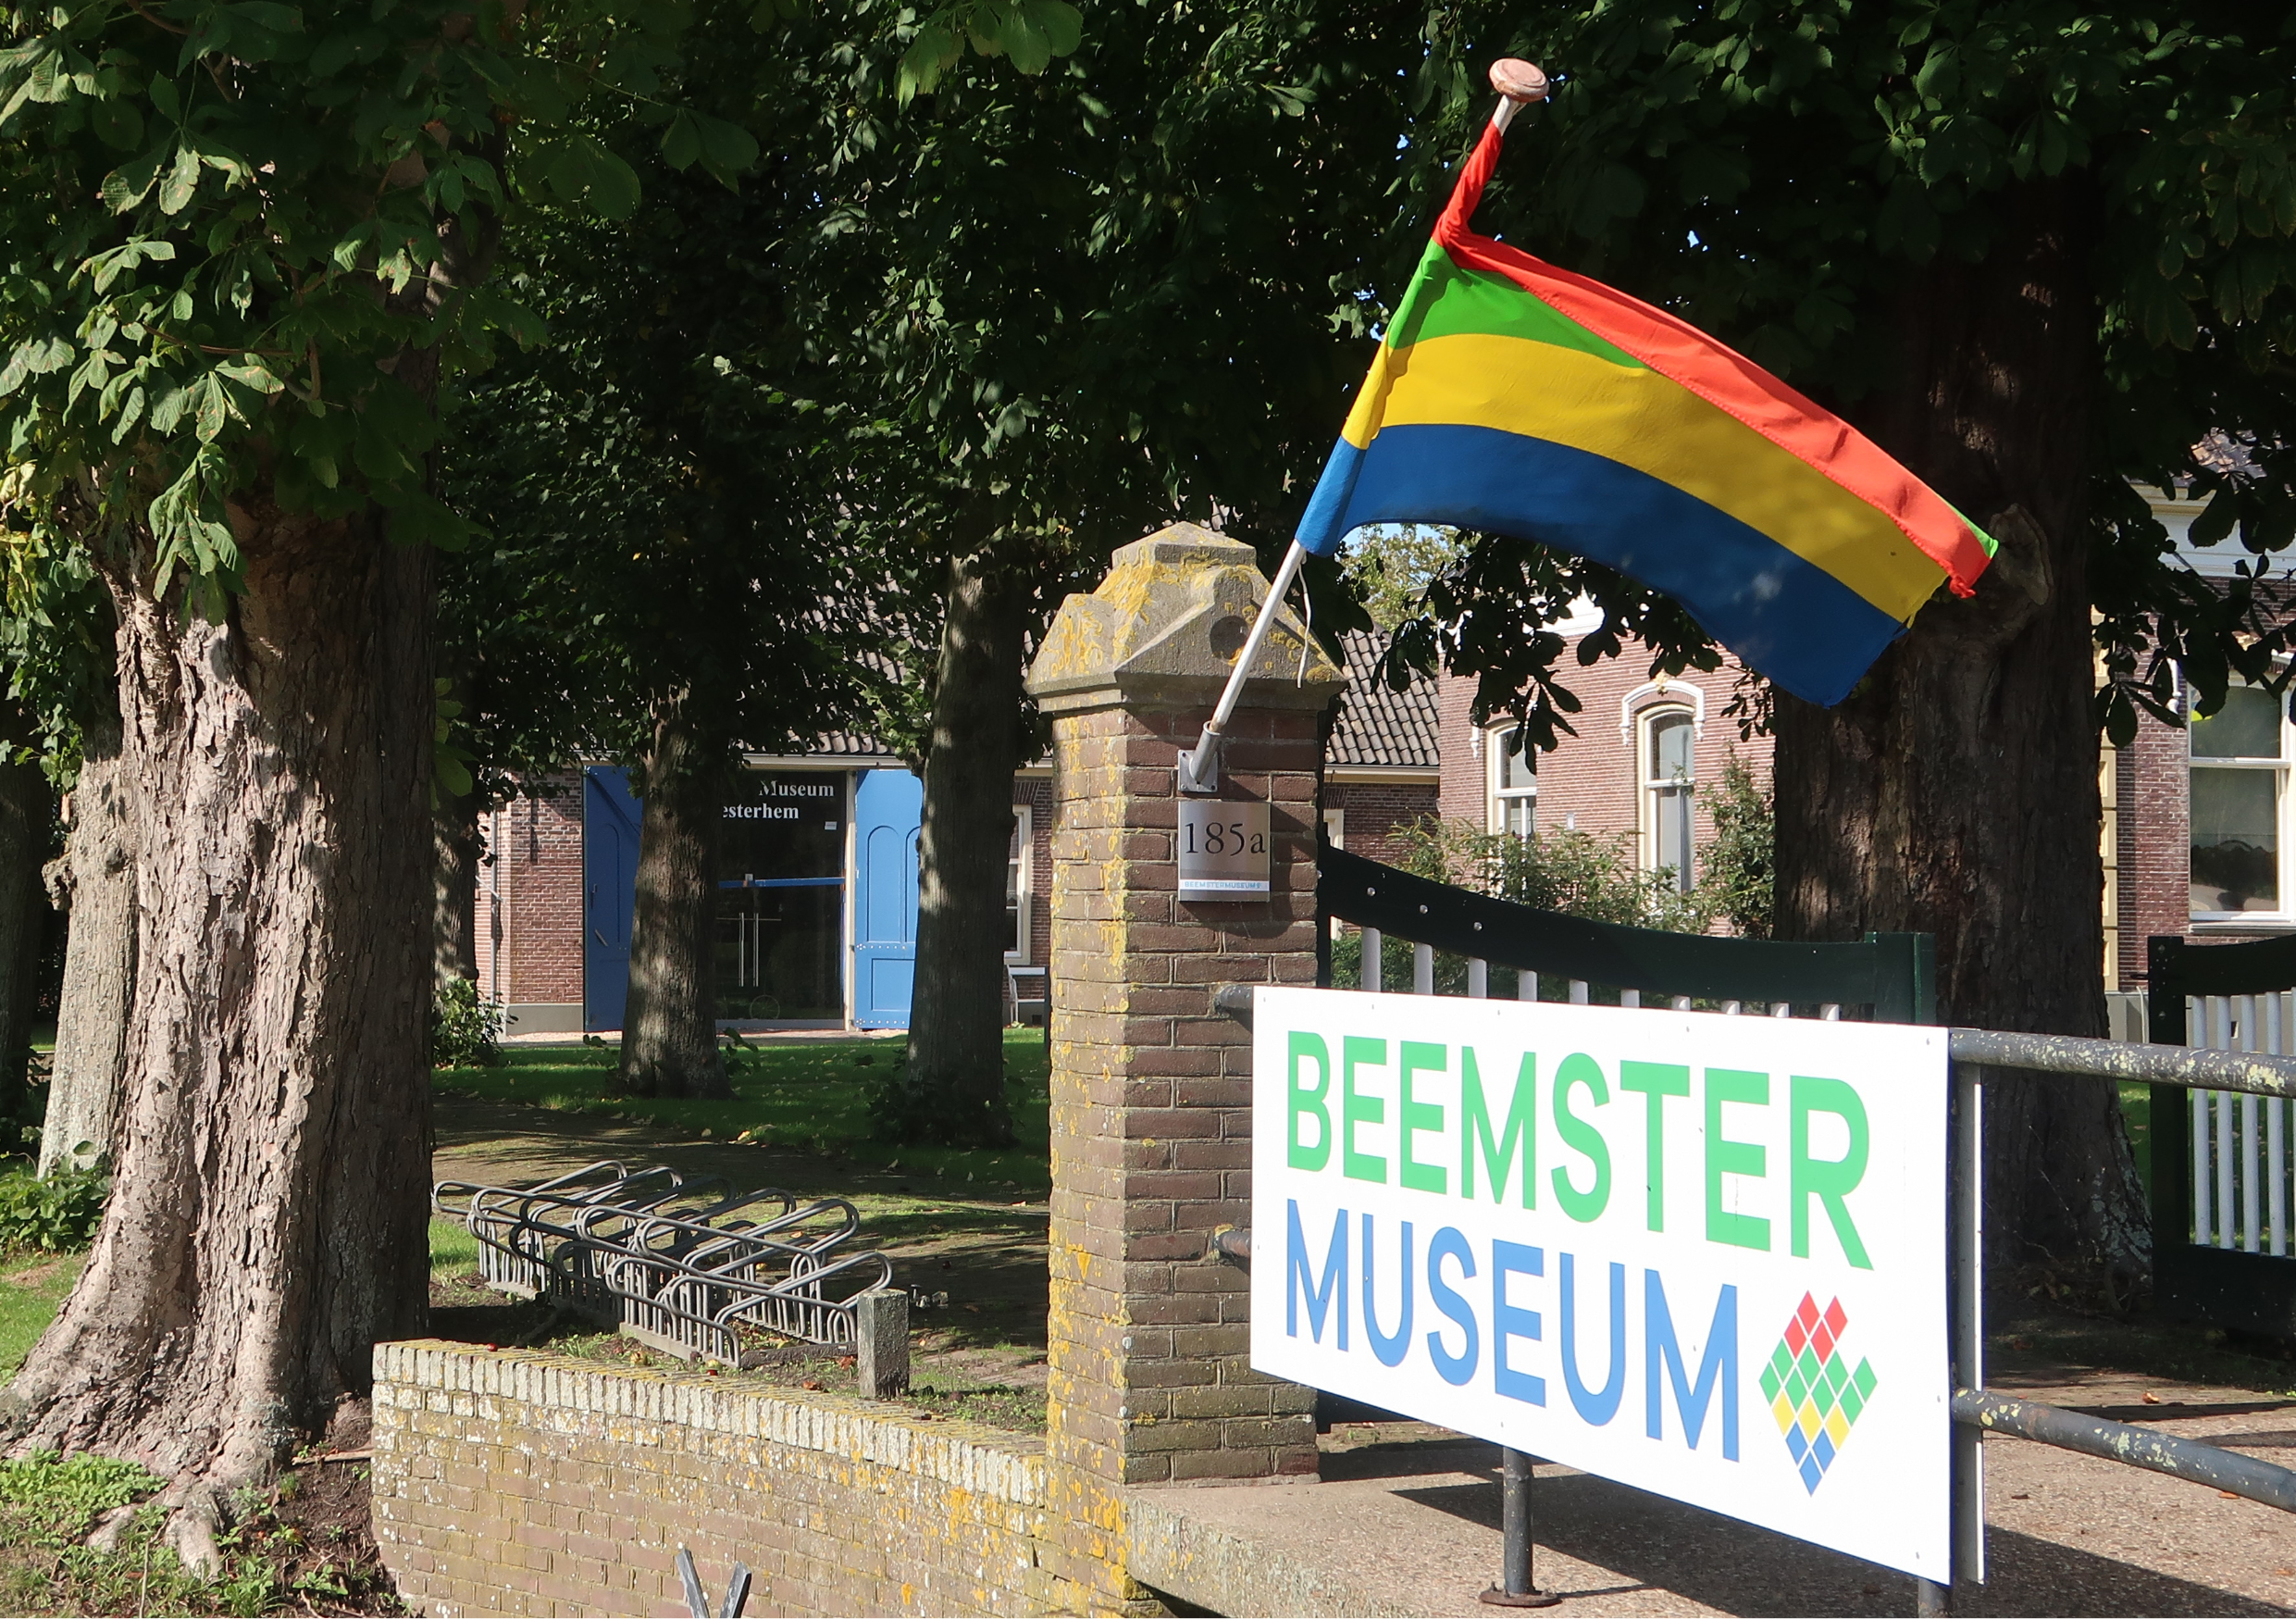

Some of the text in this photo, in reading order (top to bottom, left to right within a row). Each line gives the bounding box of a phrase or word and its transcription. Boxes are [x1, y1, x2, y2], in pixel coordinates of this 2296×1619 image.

[759, 780, 834, 796] Museum
[722, 803, 799, 818] esterhem
[1185, 822, 1266, 855] 185a
[1288, 1030, 1873, 1269] BEEMSTER
[1286, 1199, 1740, 1462] MUSEUM
